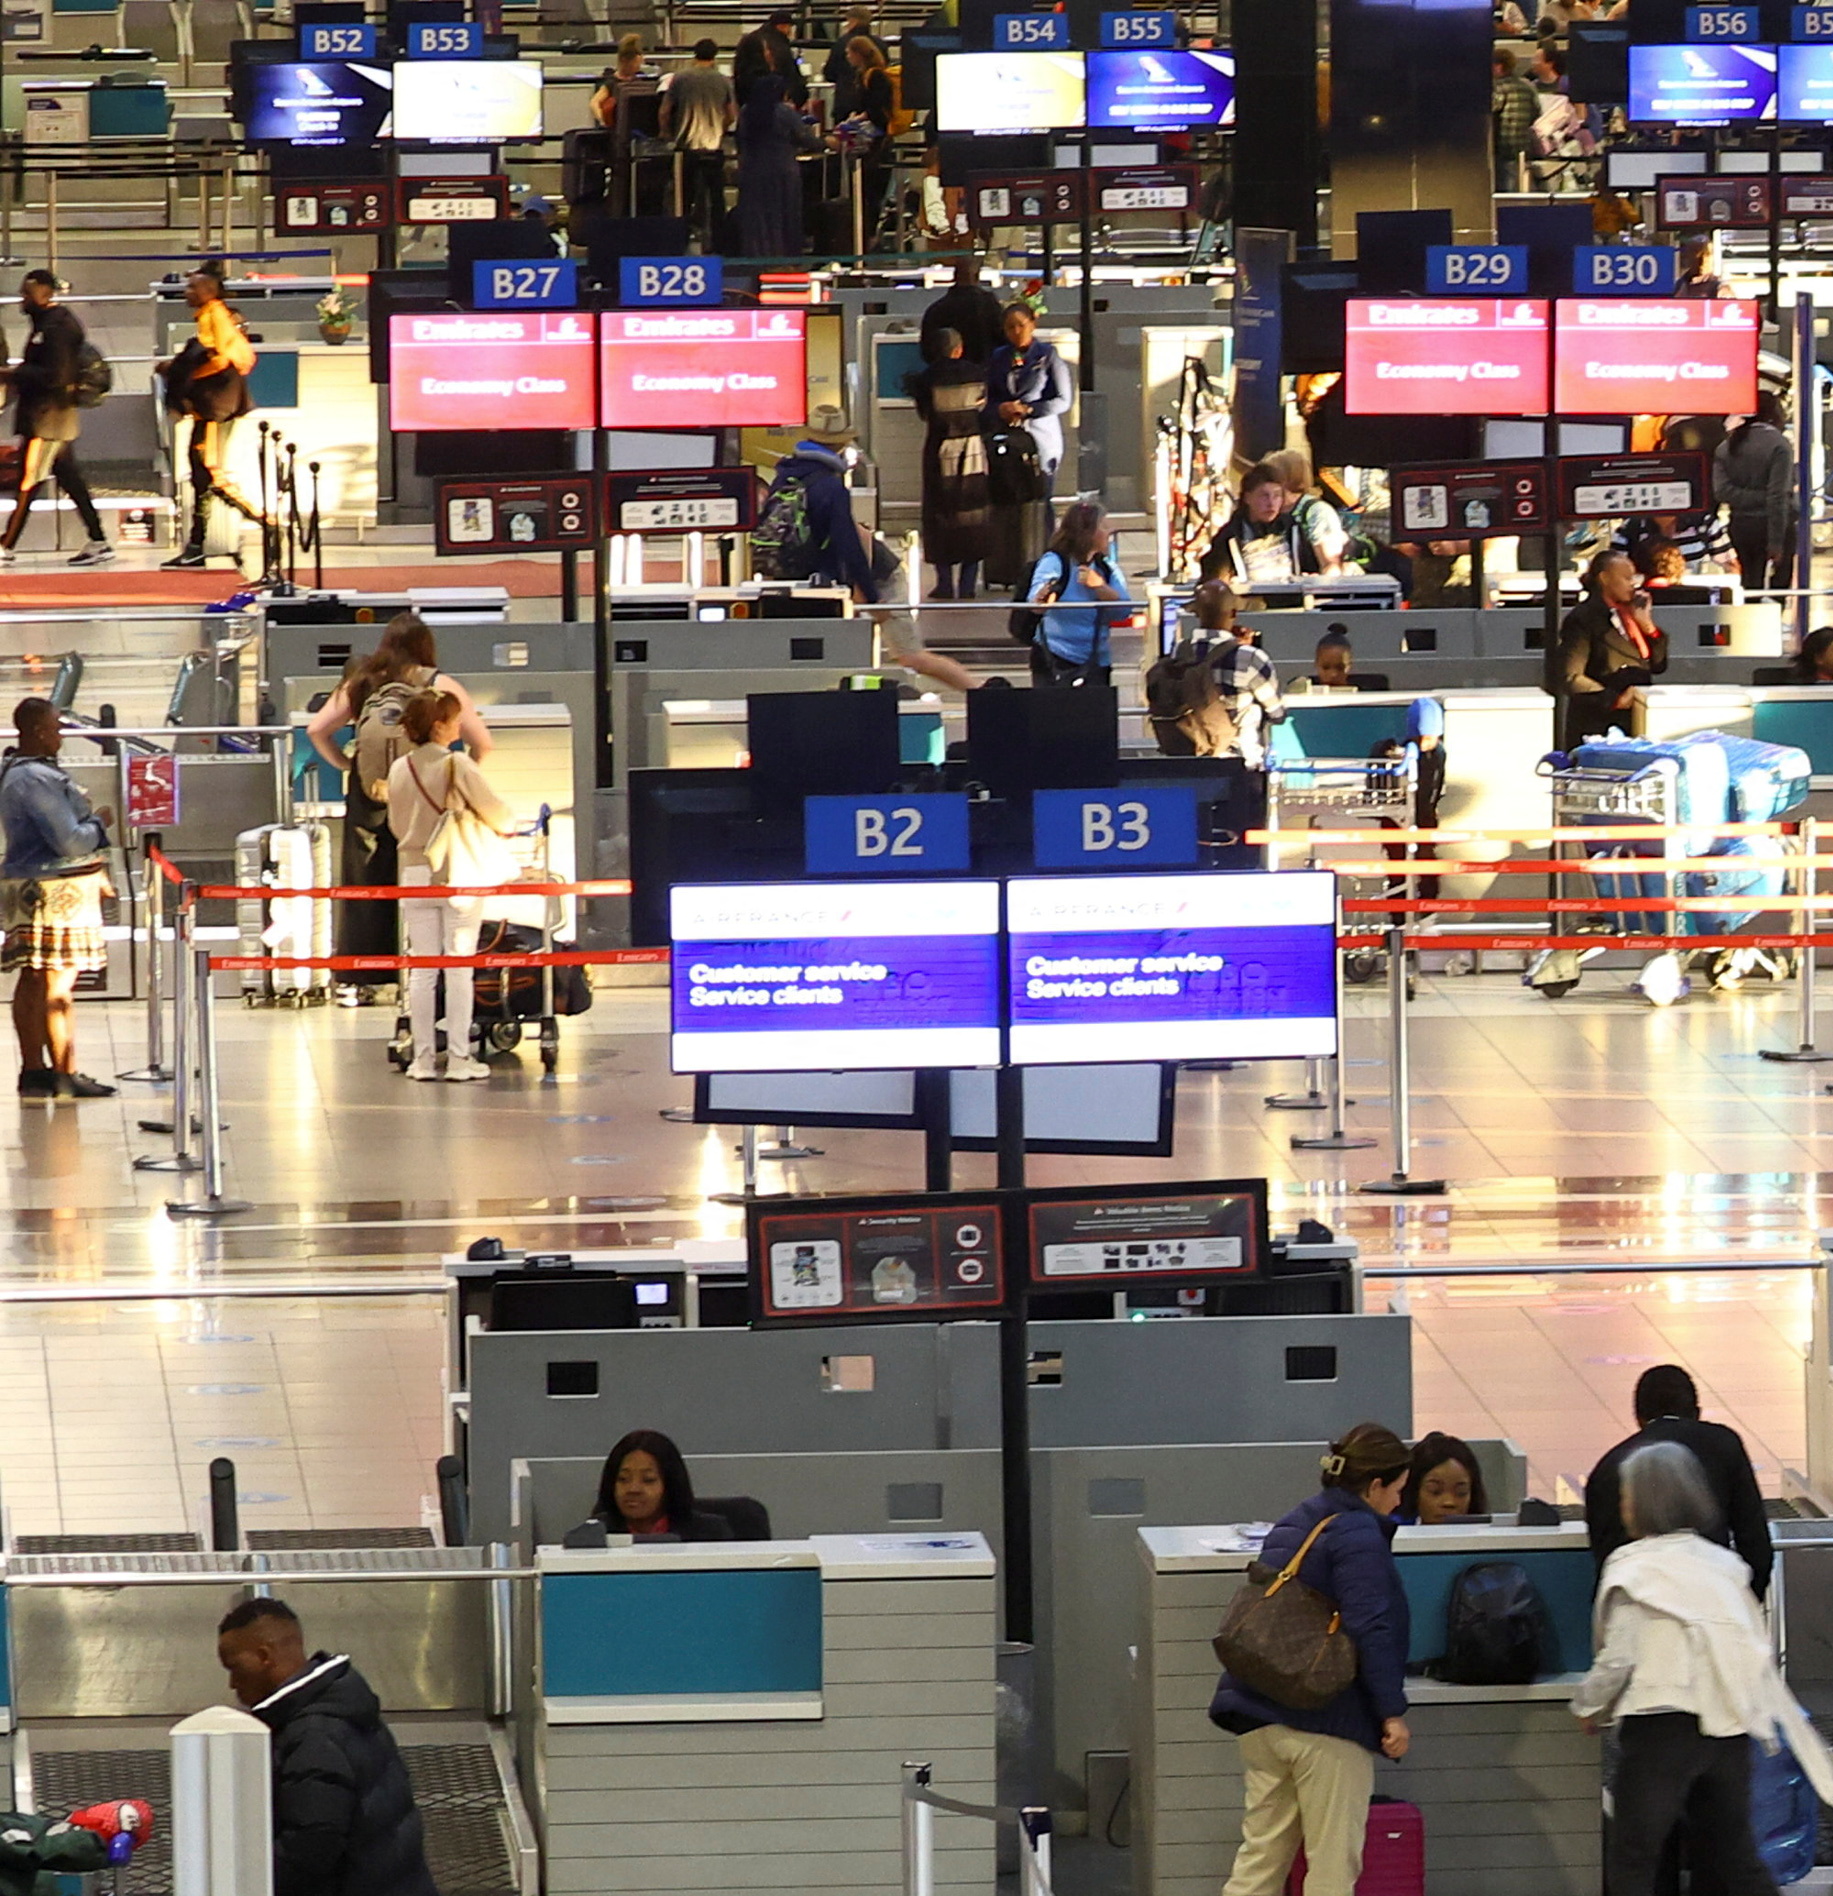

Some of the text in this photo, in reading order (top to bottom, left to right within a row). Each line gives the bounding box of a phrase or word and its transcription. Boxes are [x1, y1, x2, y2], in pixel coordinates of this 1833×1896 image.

[1008, 20, 1056, 42] B54
[1114, 18, 1161, 40] B55
[1700, 13, 1747, 35] B56
[315, 30, 363, 52] B52
[422, 29, 469, 51] B53
[1447, 254, 1510, 284] B29
[1594, 255, 1657, 284] B30
[494, 268, 559, 298] B27
[640, 266, 705, 295] B28
[1377, 362, 1520, 381] Economy Class
[1586, 362, 1729, 381] Economy Class
[422, 377, 566, 396] Economy Class
[632, 374, 777, 392] Economy Class
[857, 808, 922, 856] B2
[1083, 803, 1149, 850] B3
[689, 962, 887, 983] Customer service
[1026, 952, 1223, 976] Customer service
[690, 985, 843, 1006] Service clients
[1027, 977, 1179, 998] Service clients
